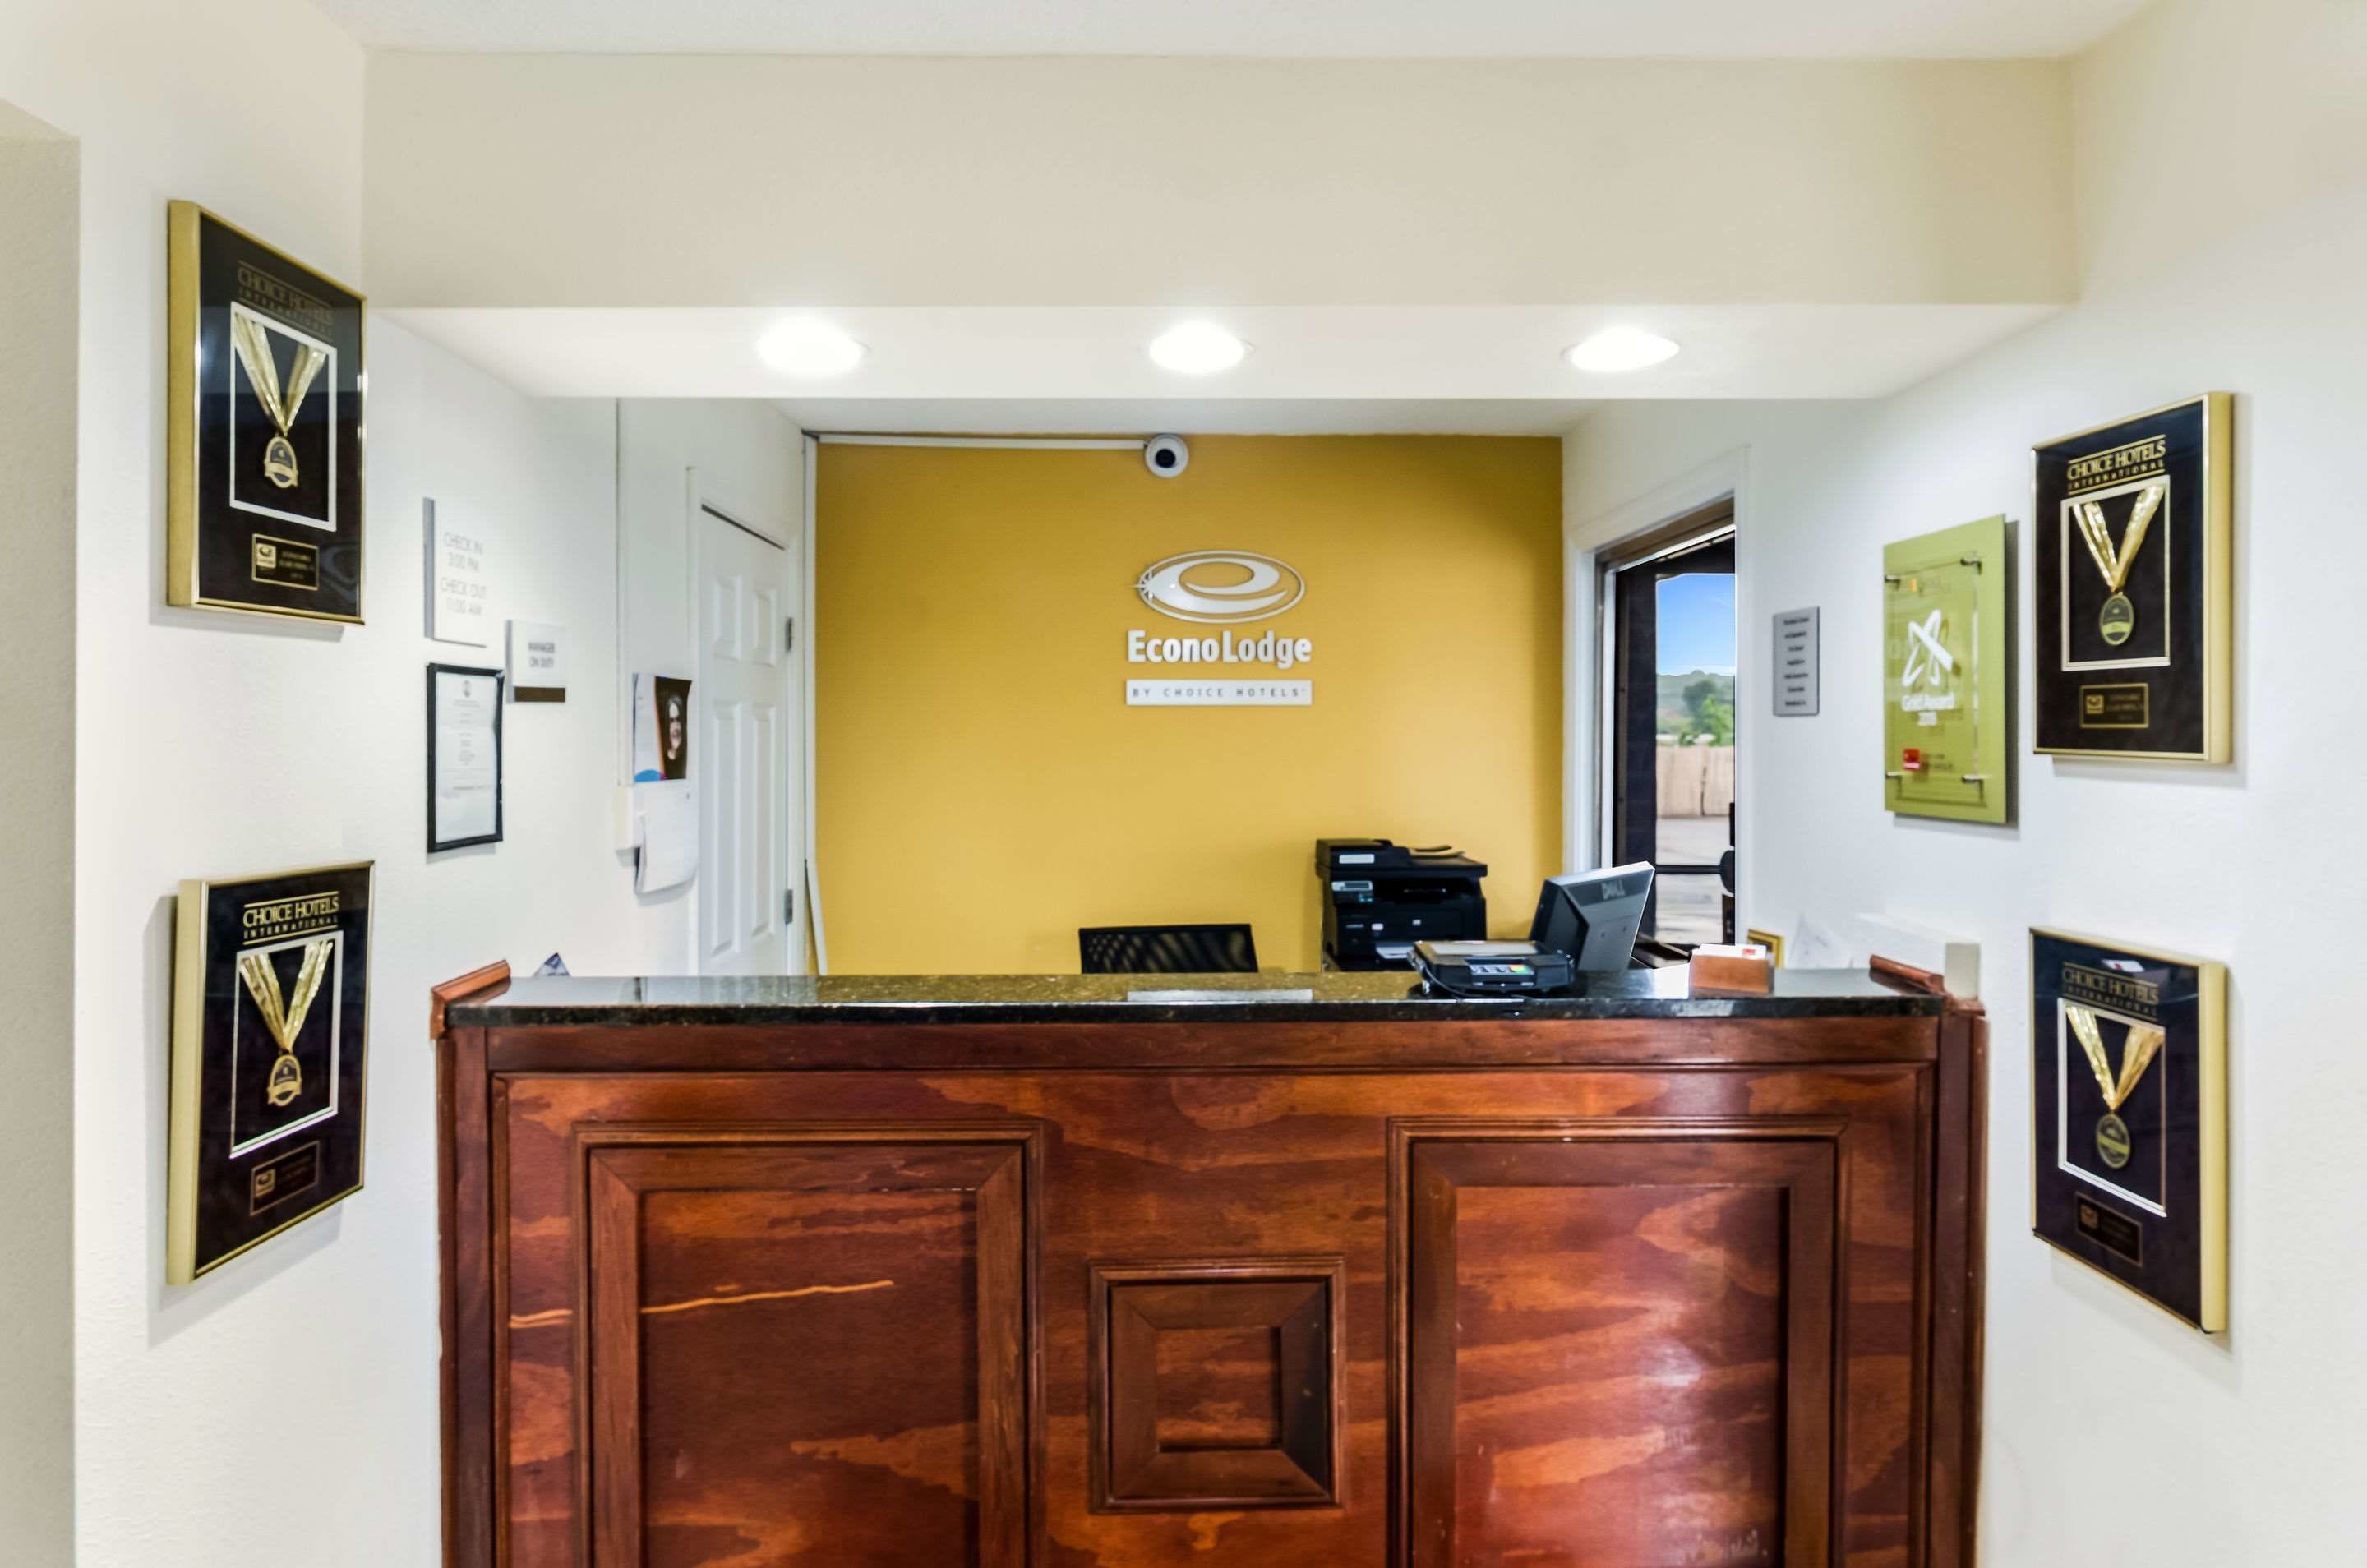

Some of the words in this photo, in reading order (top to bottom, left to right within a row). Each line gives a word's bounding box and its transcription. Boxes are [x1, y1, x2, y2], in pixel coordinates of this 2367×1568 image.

[238, 265, 288, 307] CHOICE
[2066, 454, 2114, 481] CHOICE
[2115, 440, 2166, 468] HOTELS
[2068, 459, 2164, 490] INTERNATIONAL
[444, 531, 471, 551] CHECK
[440, 576, 468, 596] CHECK
[1133, 688, 1151, 697] BY
[1163, 688, 1224, 697] CHOICE
[243, 903, 293, 928] CHOICE
[295, 896, 339, 919] HOTELS
[243, 915, 338, 939] INTERNATIONAL
[2062, 967, 2106, 991] CHOICE
[2109, 977, 2158, 1005] HOTELS
